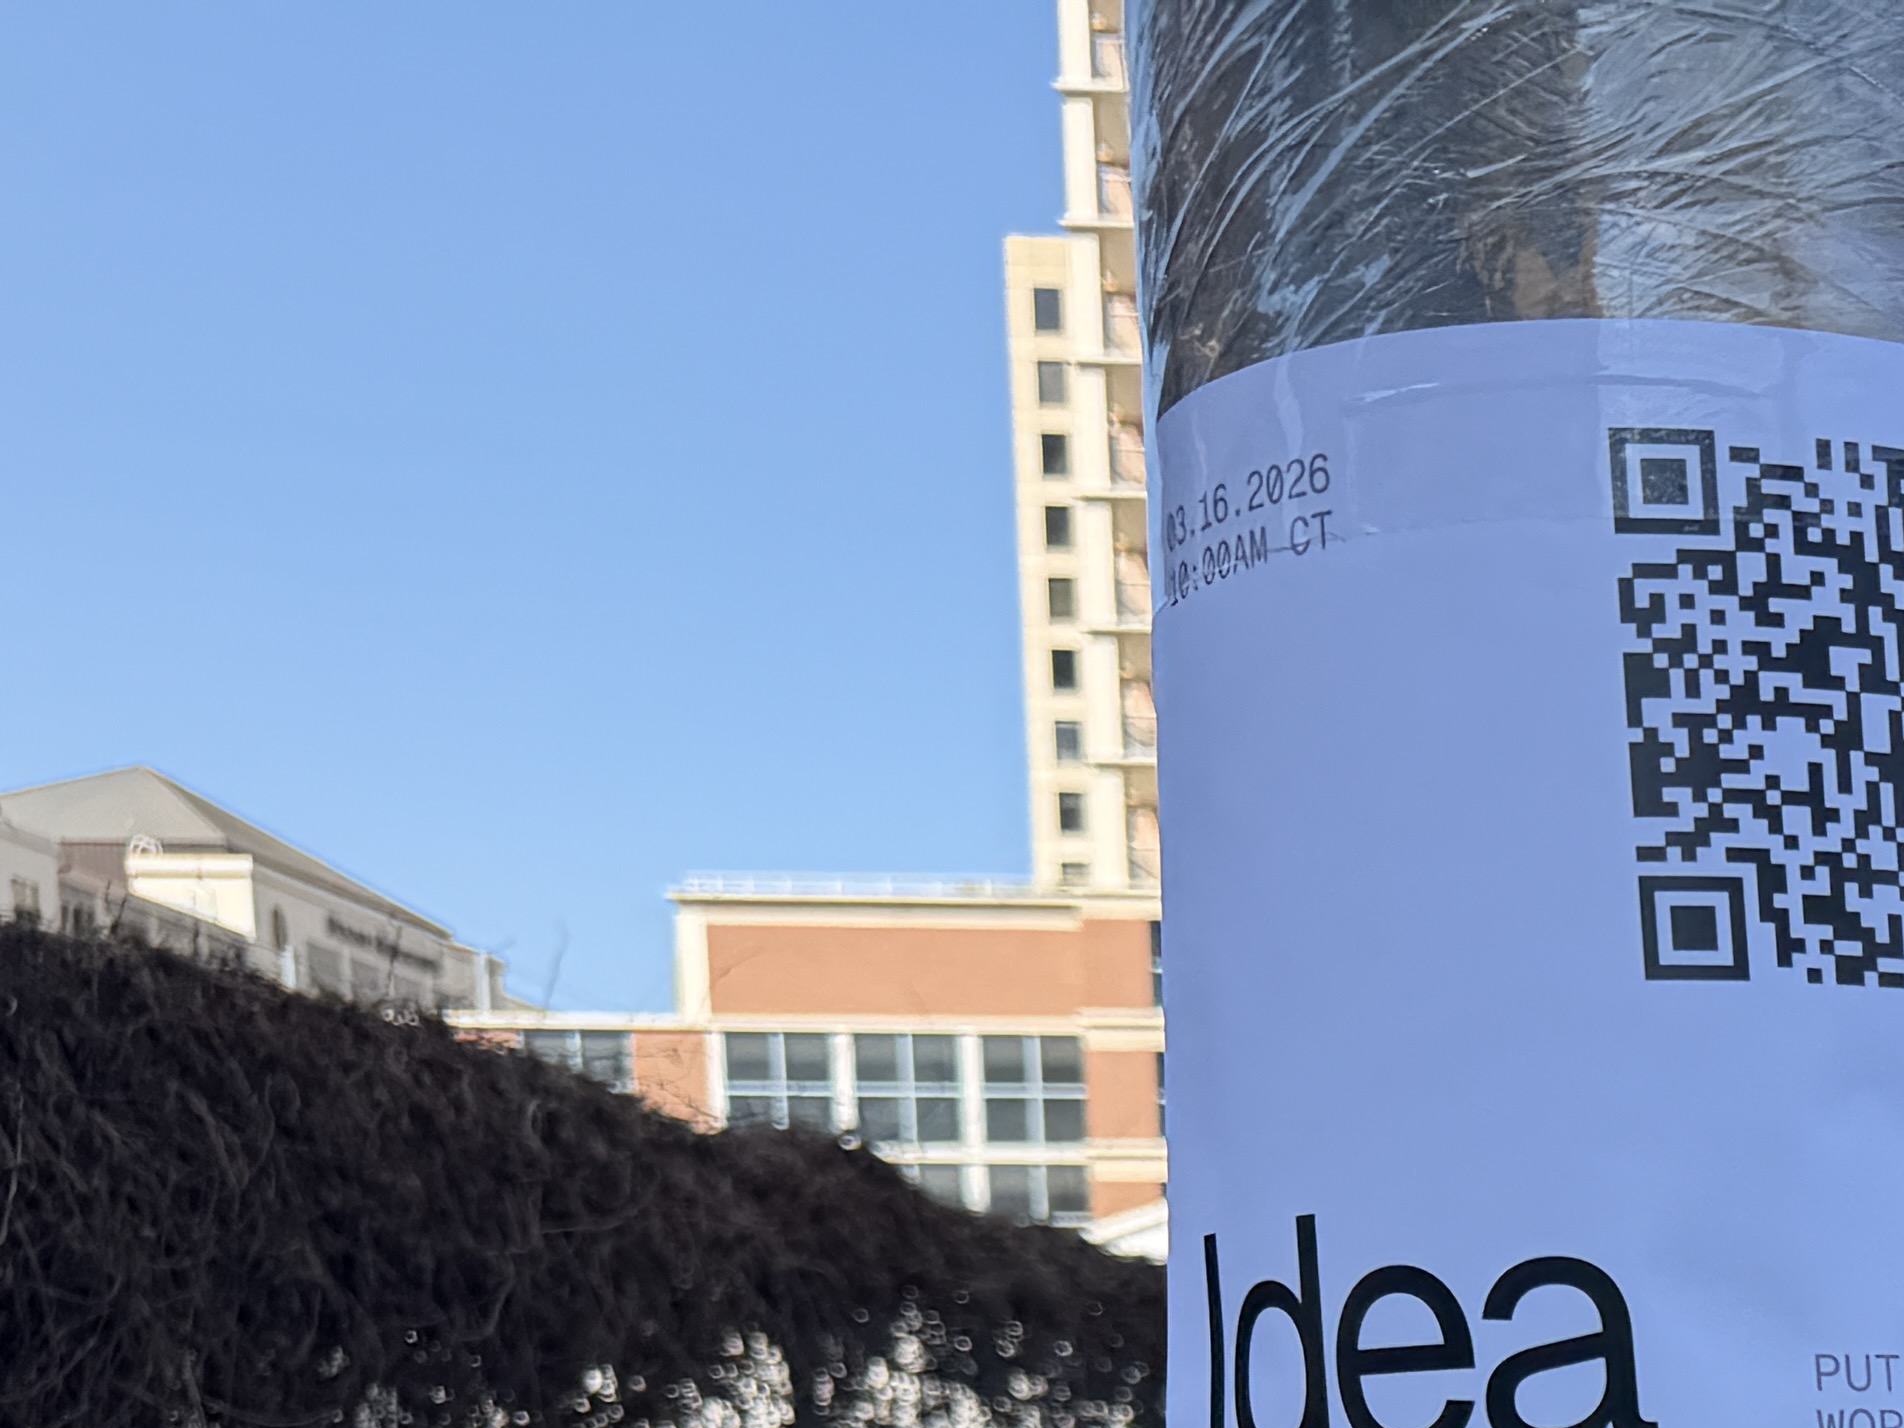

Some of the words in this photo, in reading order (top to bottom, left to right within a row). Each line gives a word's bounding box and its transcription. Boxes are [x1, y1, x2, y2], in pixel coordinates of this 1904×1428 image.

[1166, 453, 1330, 552] 03.16.2026
[1290, 509, 1333, 556] CT
[1815, 1354, 1900, 1392] PUT
